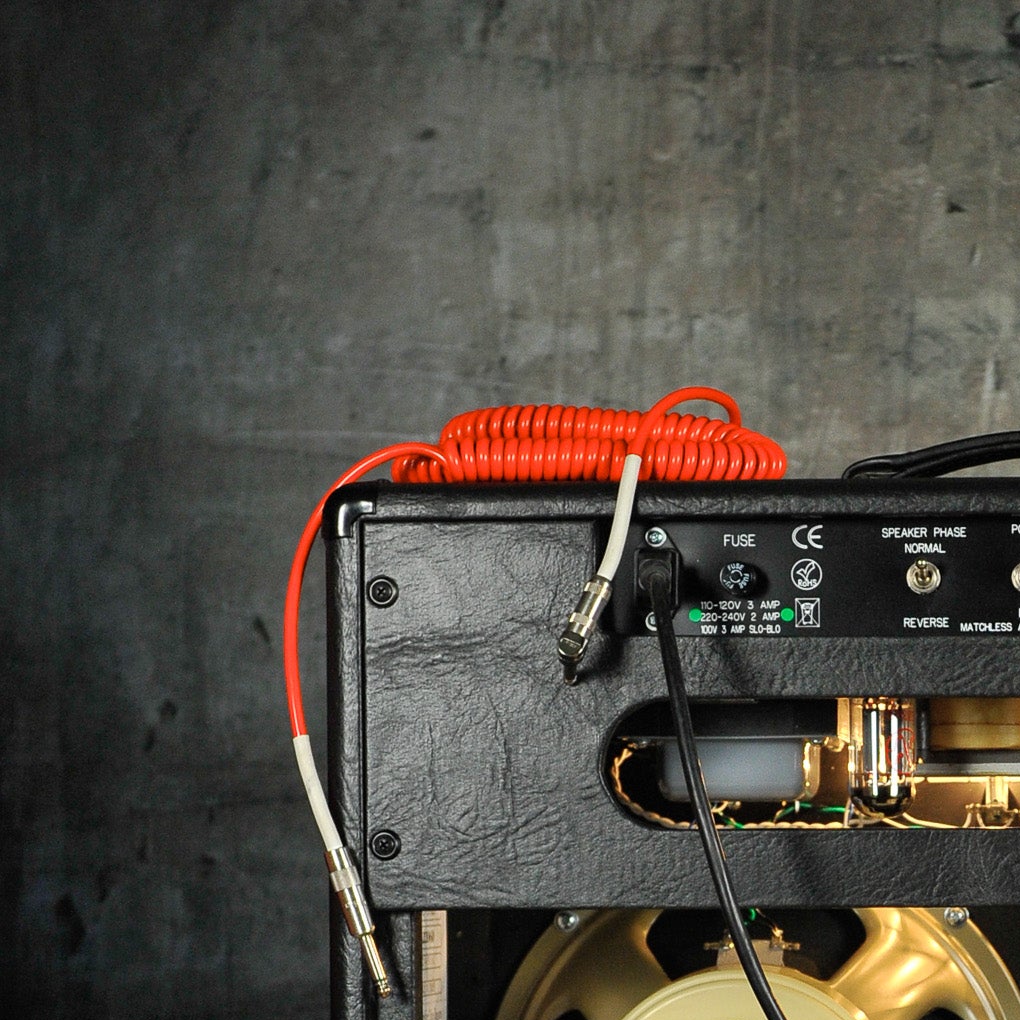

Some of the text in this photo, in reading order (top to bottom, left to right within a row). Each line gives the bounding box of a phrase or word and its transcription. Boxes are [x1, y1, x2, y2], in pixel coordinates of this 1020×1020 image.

[881, 527, 967, 538] SPEAKER PHASE
[723, 534, 756, 547] FUSE
[904, 543, 946, 554] NORMAL
[700, 601, 780, 610] 110-120V 3 AMP
[700, 612, 780, 622] 220-240V 2 AMP
[903, 617, 949, 628] REVERSE
[960, 622, 1012, 632] MATCHLESS
[701, 625, 717, 634] 100V
[722, 625, 727, 634] 3
[730, 625, 745, 634] AMP
